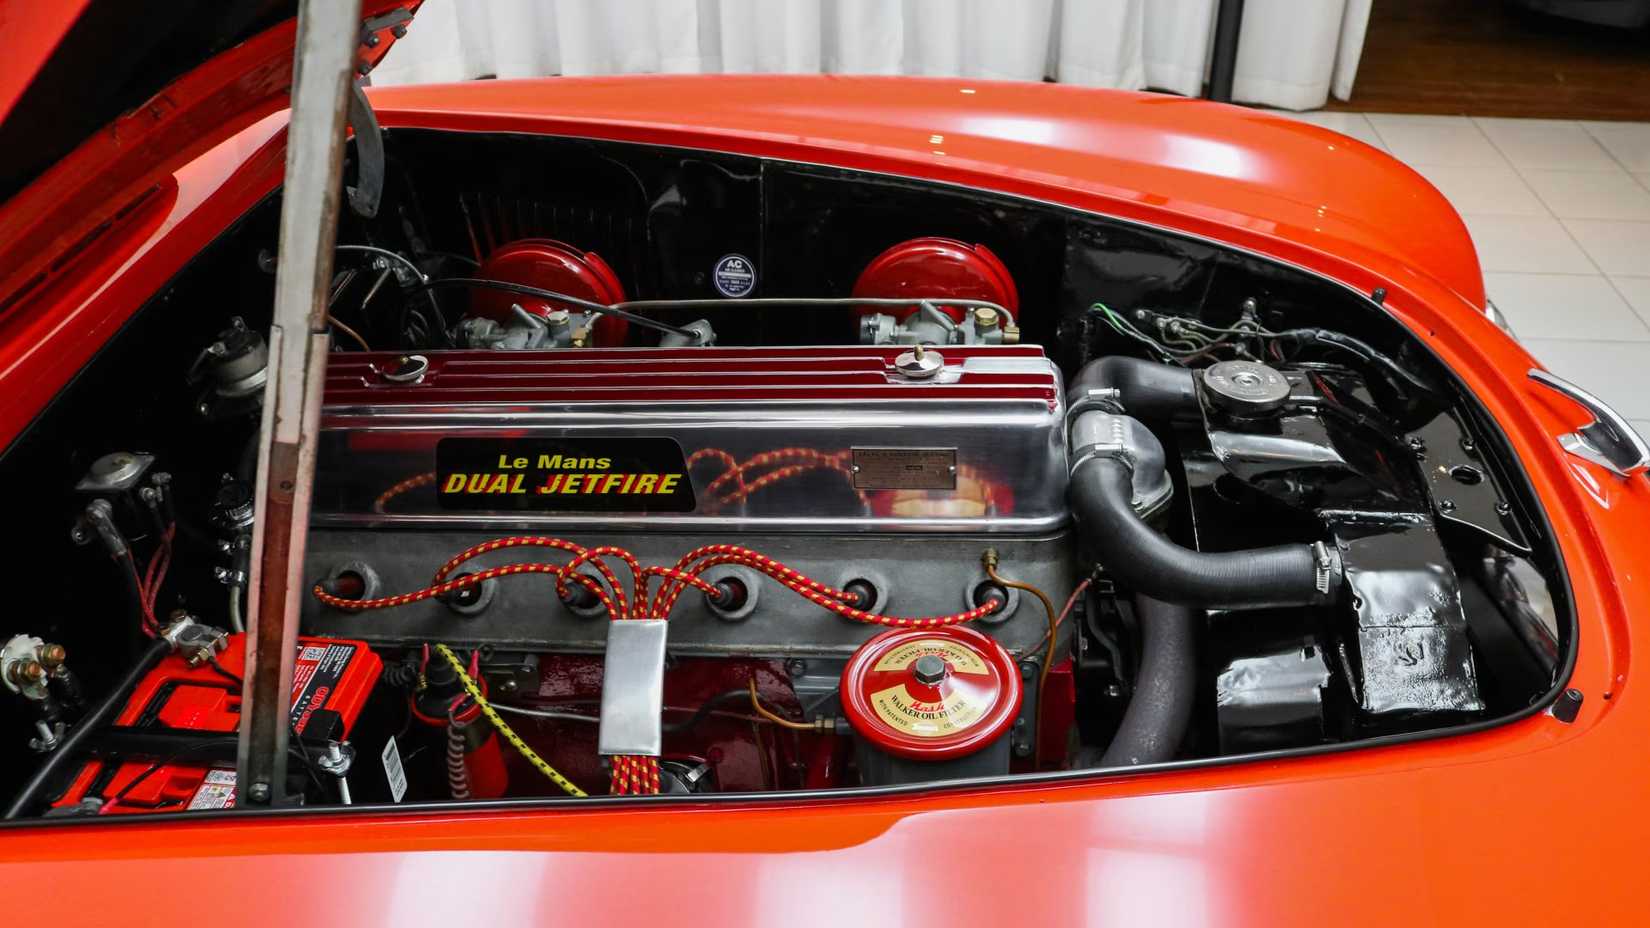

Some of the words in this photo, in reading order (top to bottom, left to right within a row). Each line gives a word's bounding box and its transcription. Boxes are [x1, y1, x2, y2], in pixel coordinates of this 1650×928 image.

[727, 260, 742, 268] AC
[498, 454, 529, 469] Le
[537, 454, 612, 469] Mans
[442, 473, 527, 495] DUAL
[536, 473, 682, 495] JETFIRE
[891, 694, 920, 719] WALKER
[921, 712, 938, 720] OIL
